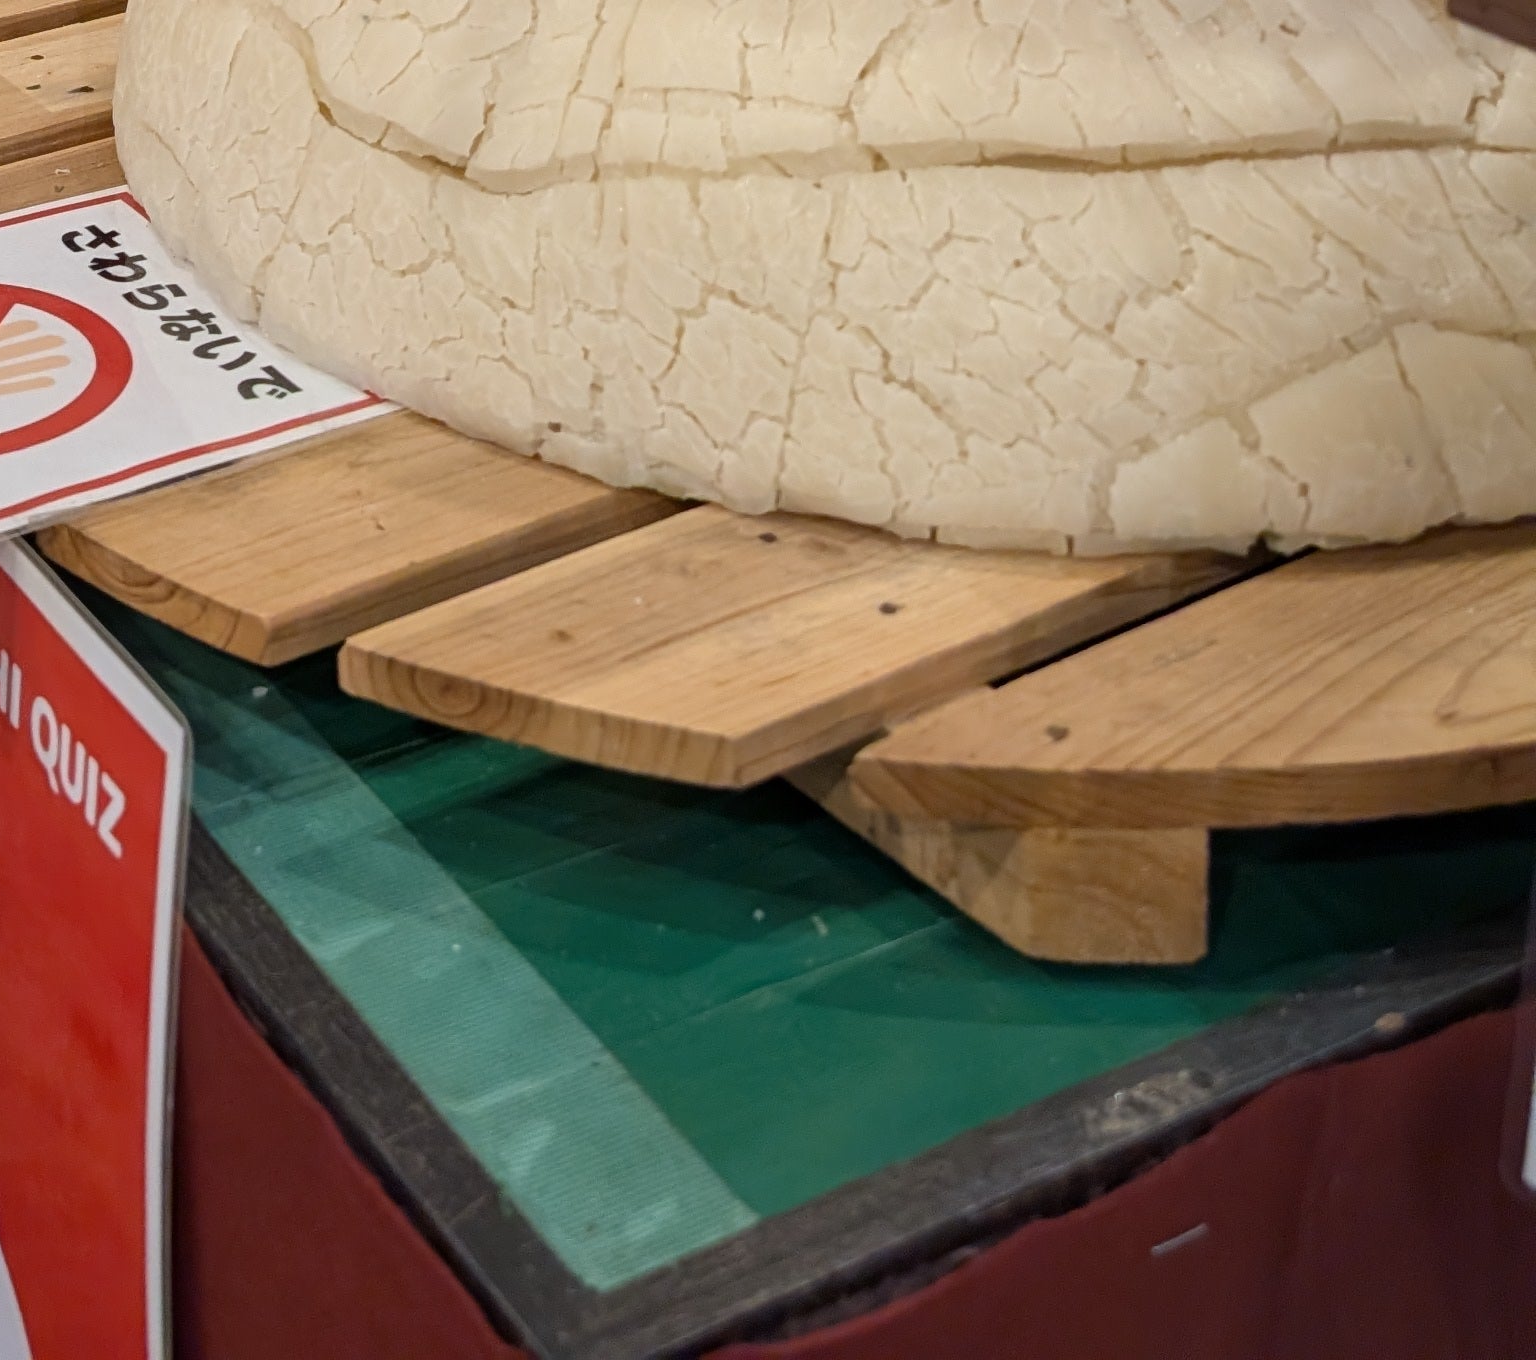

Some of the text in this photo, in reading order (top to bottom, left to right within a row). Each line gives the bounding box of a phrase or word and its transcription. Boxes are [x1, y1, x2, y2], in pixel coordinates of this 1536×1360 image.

[60, 223, 303, 402] さわらないで
[31, 696, 126, 859] QUIZ
